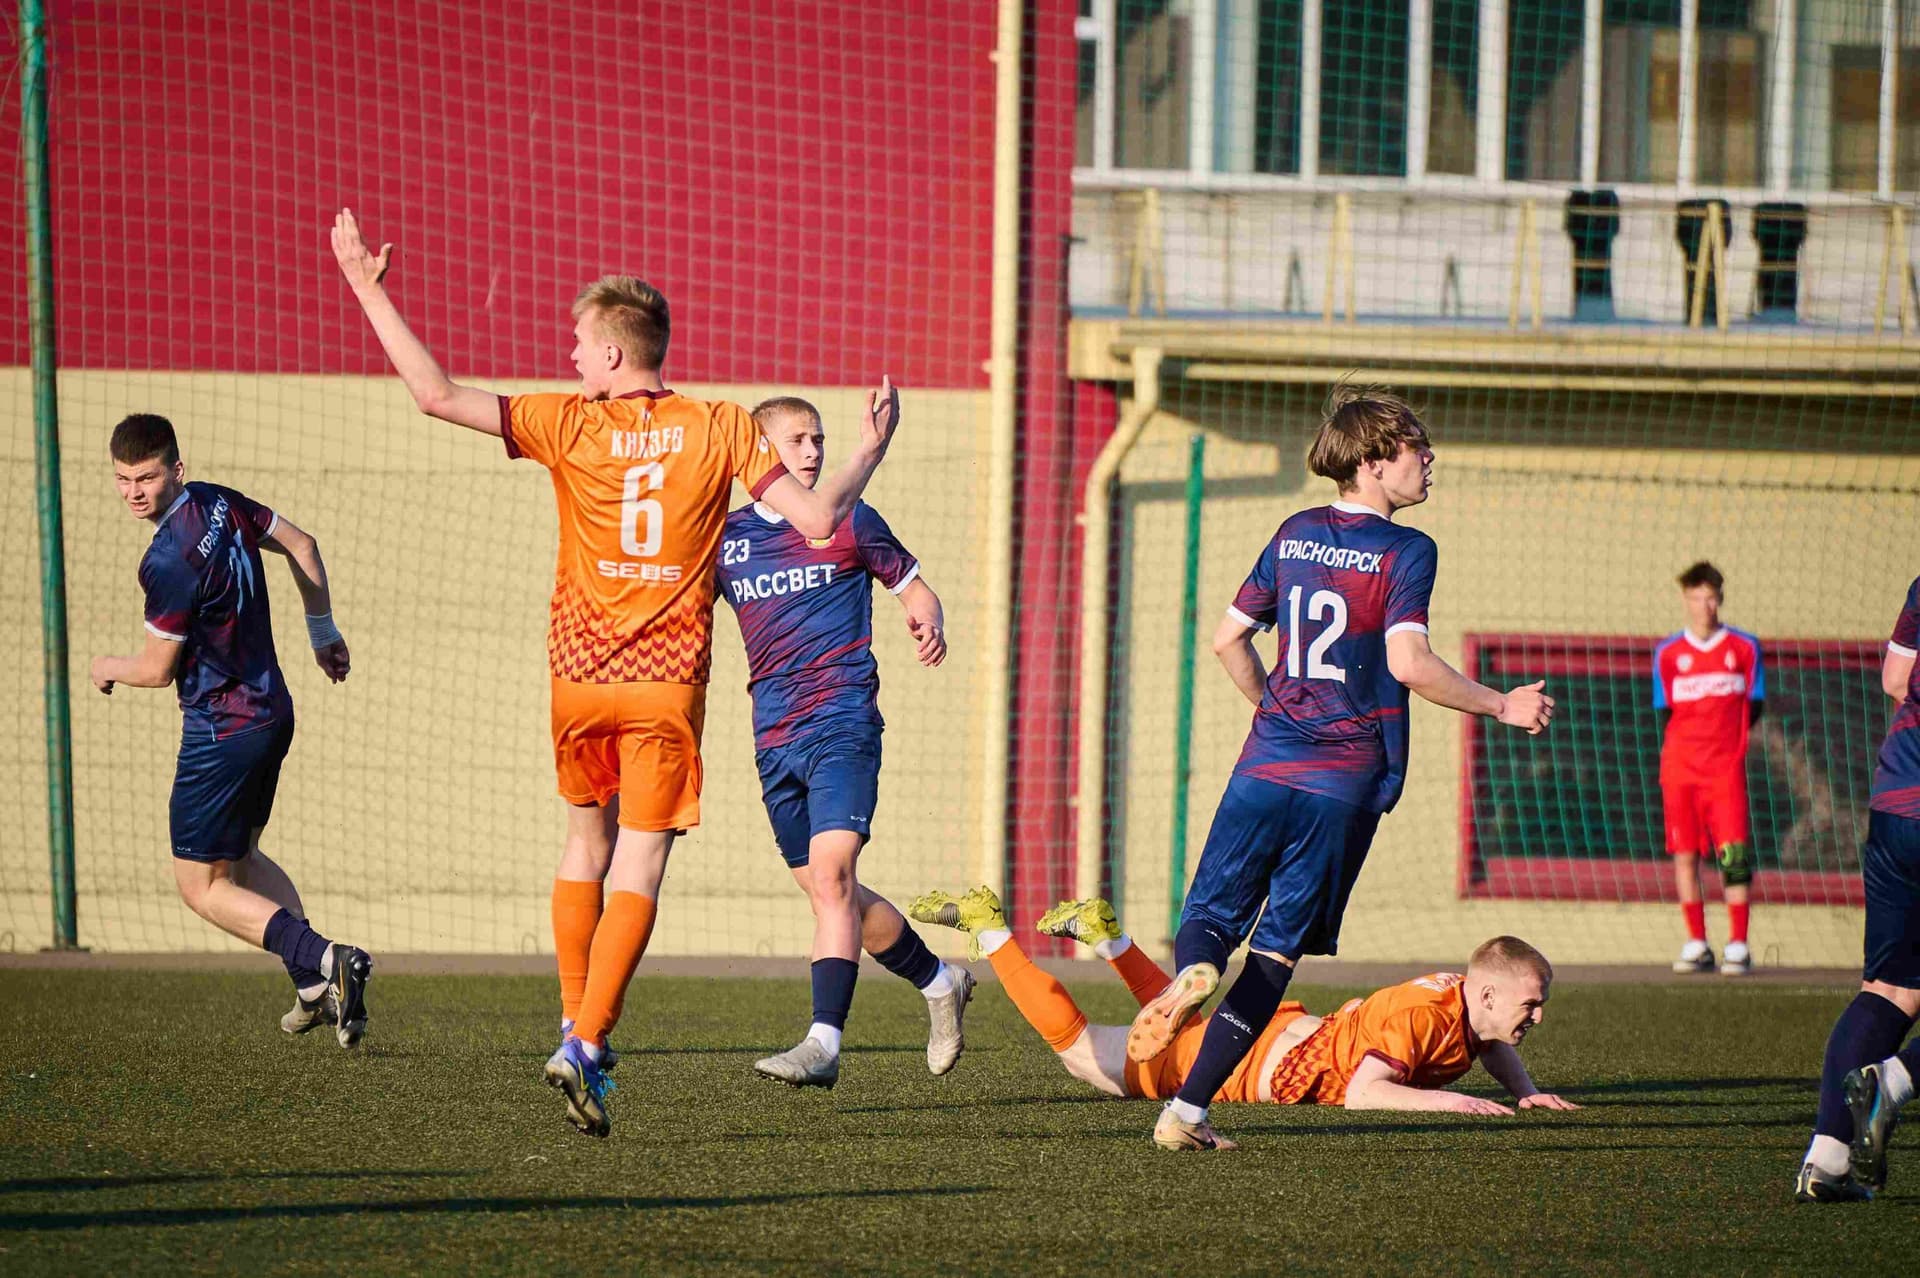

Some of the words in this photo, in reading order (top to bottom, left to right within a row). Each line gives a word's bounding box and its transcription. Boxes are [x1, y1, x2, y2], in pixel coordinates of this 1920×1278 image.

[620, 461, 664, 556] 6
[723, 539, 750, 566] 23
[1278, 539, 1383, 573] КРАСНОЯРСК
[731, 564, 836, 603] РАССВЕТ
[1288, 585, 1347, 684] 12
